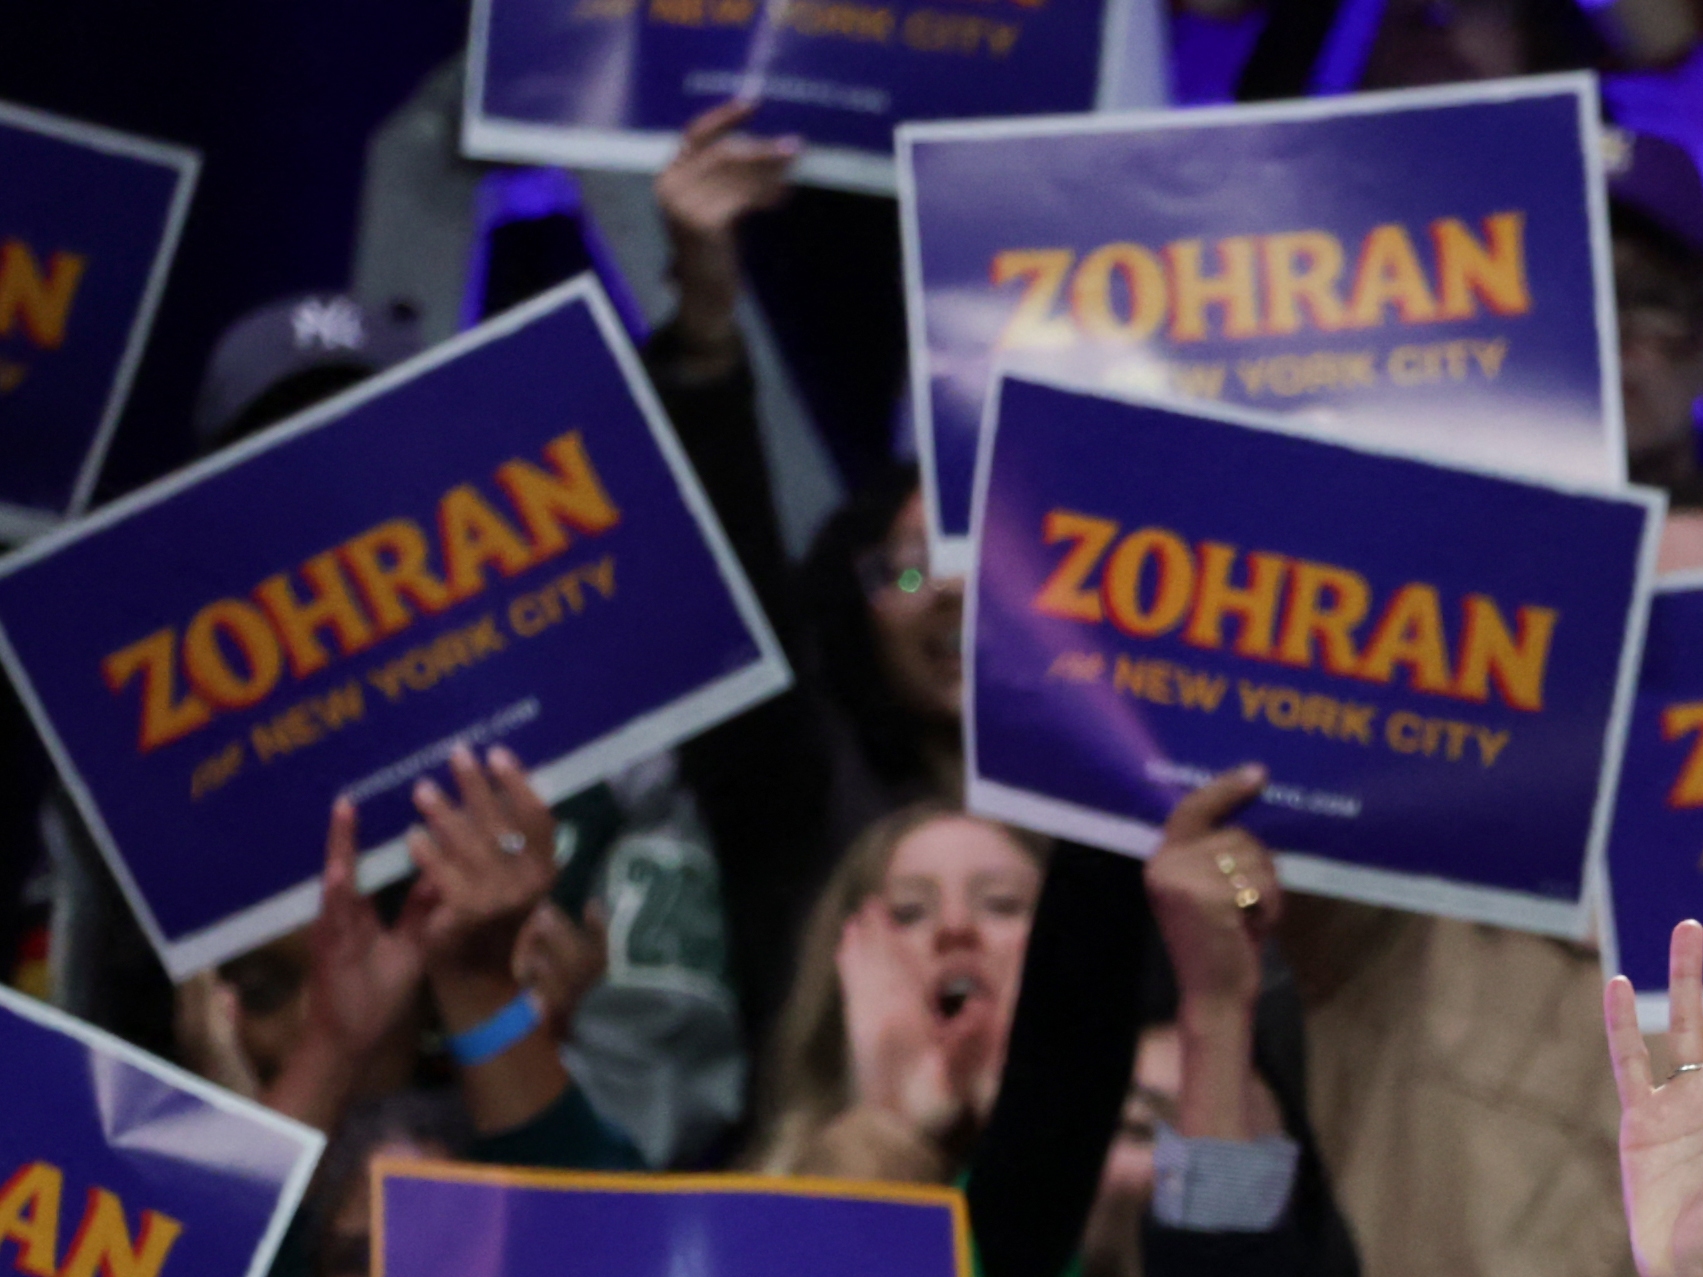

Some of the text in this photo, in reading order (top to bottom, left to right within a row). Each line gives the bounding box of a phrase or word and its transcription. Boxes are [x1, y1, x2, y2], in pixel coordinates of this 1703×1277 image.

[989, 209, 1533, 347] ZOHRAN
[1387, 336, 1510, 387] CITY
[102, 428, 623, 757] ZOHRAN
[366, 612, 509, 702] YORK
[508, 553, 618, 640] CITY
[1032, 507, 1560, 714] ZOHRAN
[1112, 652, 1229, 715] NEW
[1236, 678, 1378, 747] YORK
[1384, 708, 1511, 769] CITY
